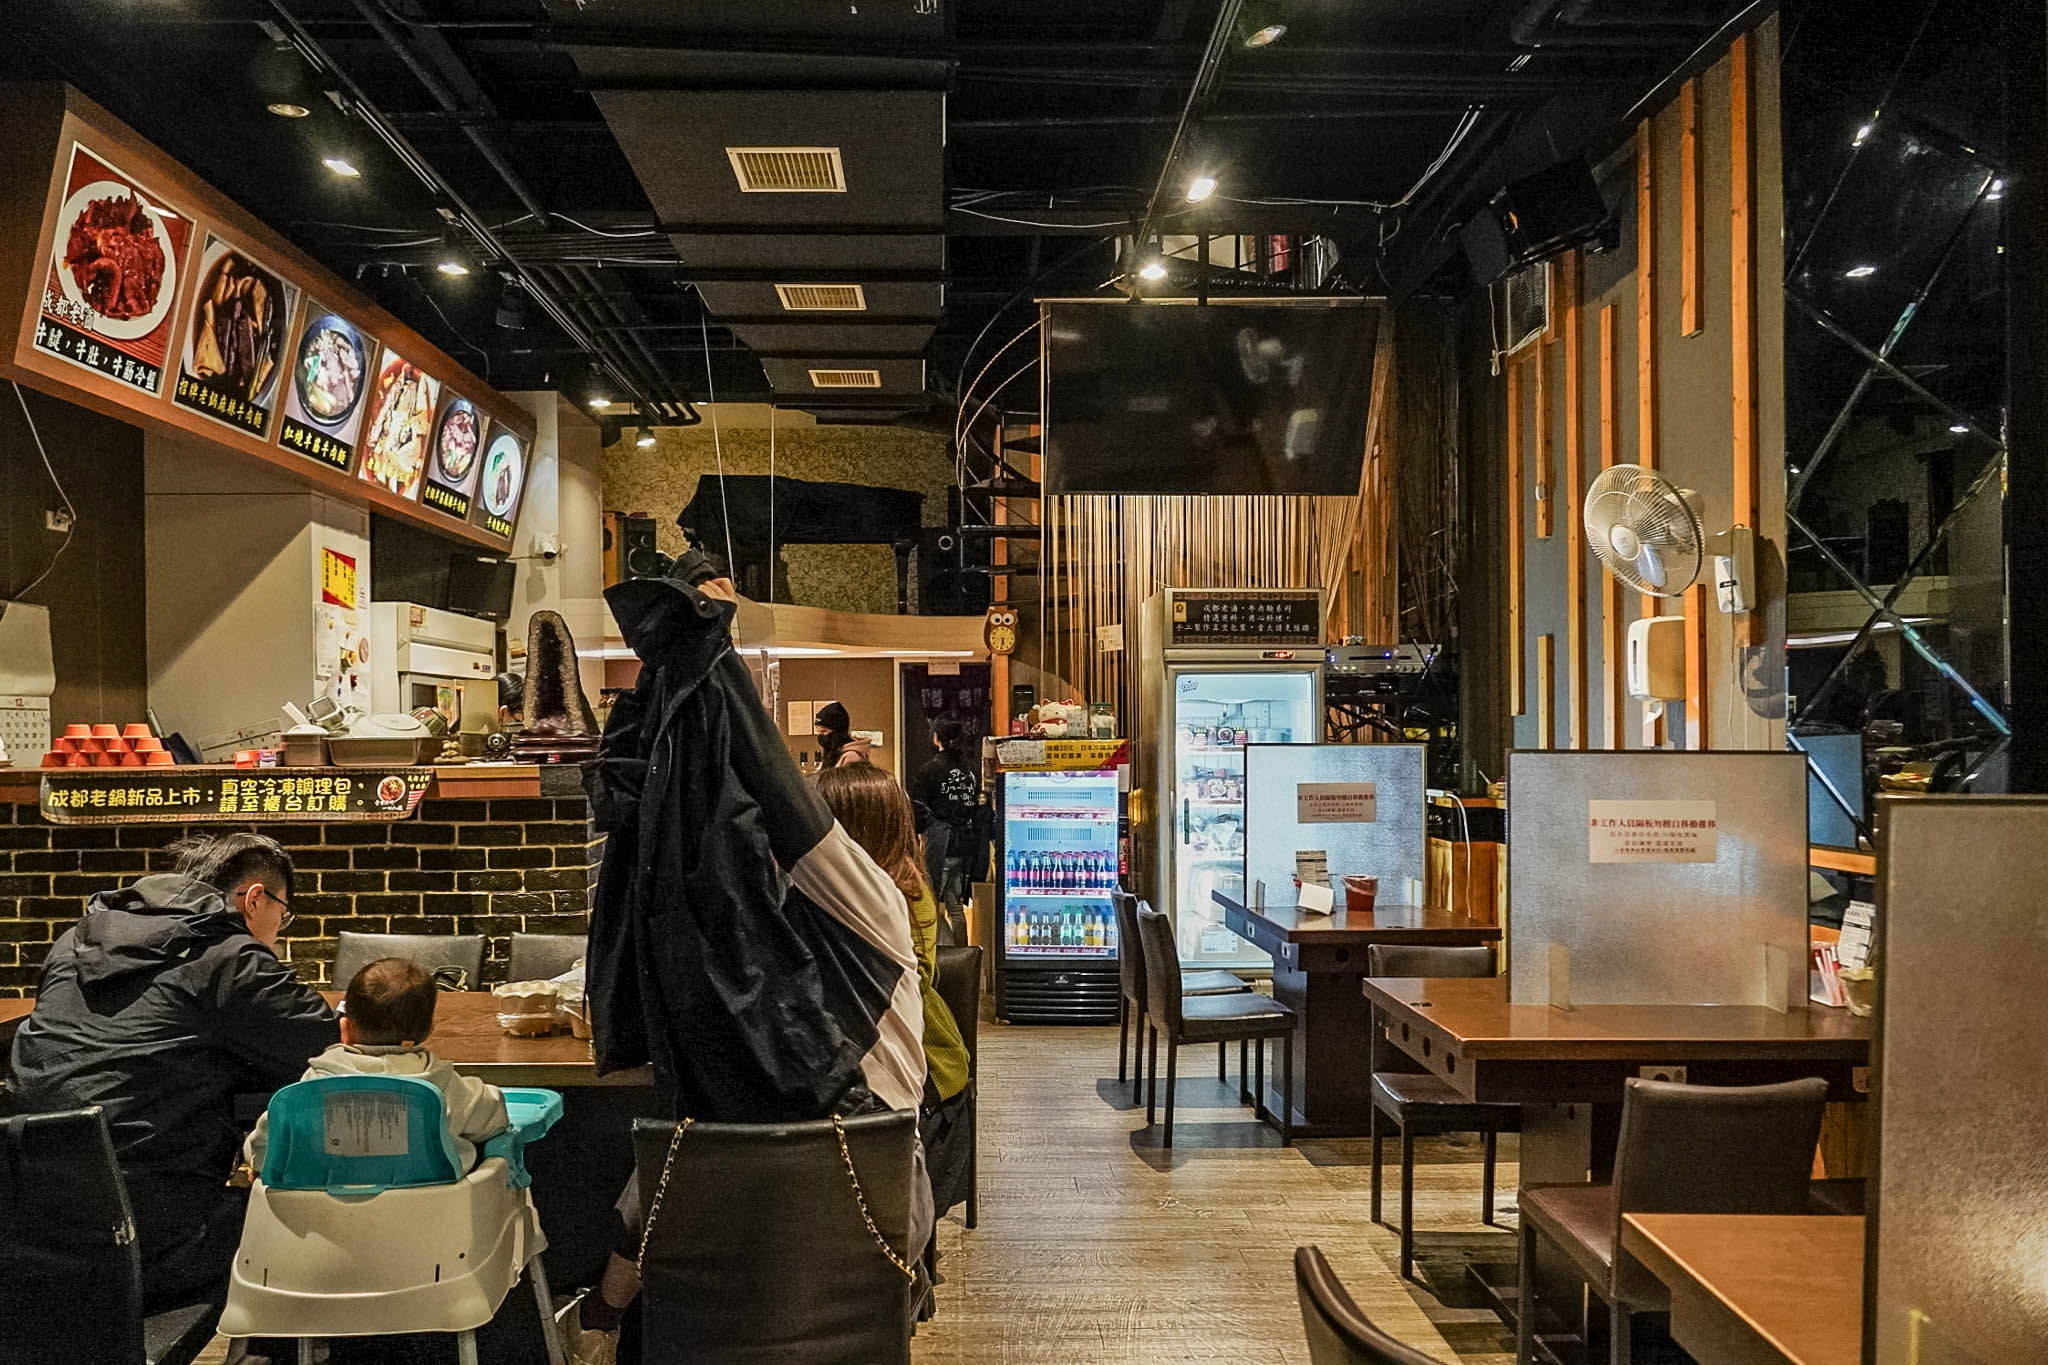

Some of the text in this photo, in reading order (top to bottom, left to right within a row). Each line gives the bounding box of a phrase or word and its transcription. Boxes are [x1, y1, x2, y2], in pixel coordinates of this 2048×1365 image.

[48, 787, 213, 808] 成都老鍋新品上市：
